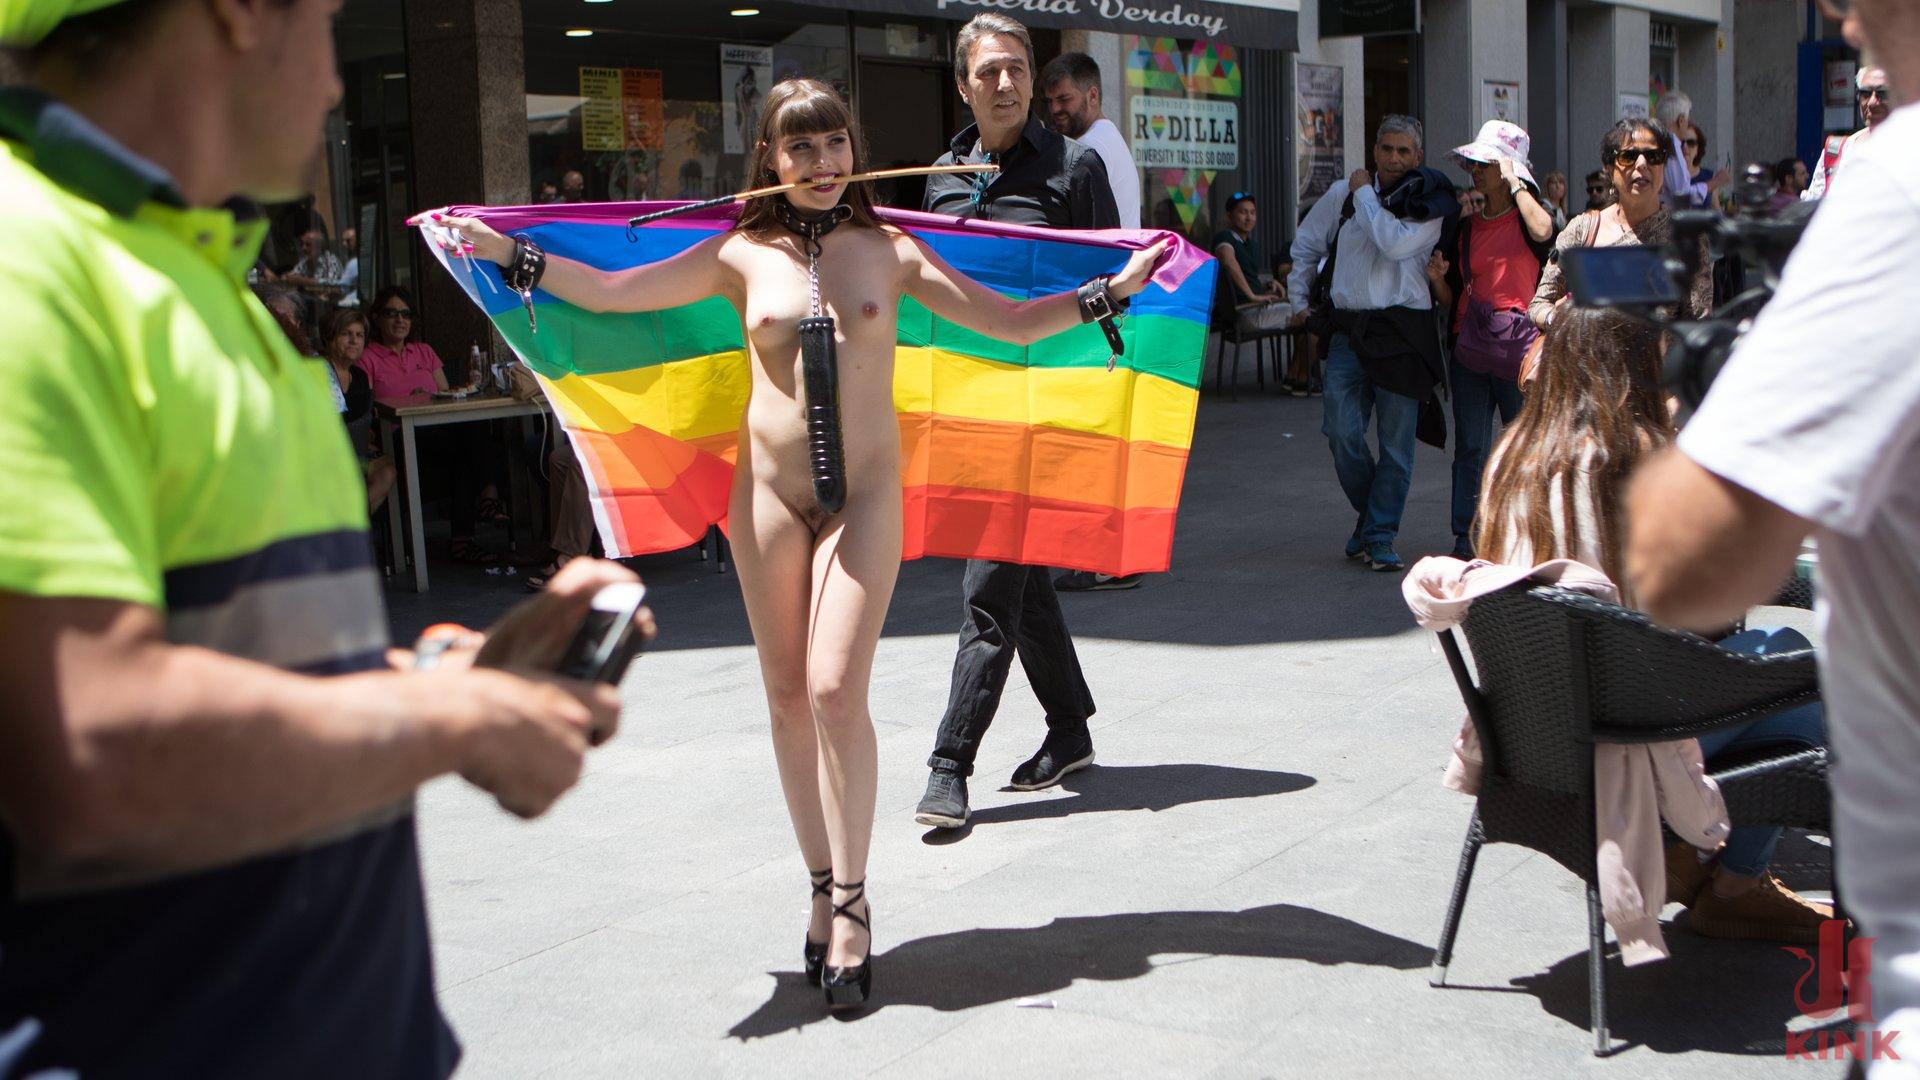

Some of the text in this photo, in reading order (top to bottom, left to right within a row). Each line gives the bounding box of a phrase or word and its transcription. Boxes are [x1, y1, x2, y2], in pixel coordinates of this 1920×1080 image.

[1091, 0, 1227, 36] Verdoy
[1136, 148, 1236, 166] DIVERSITY TASTES SO GOOD
